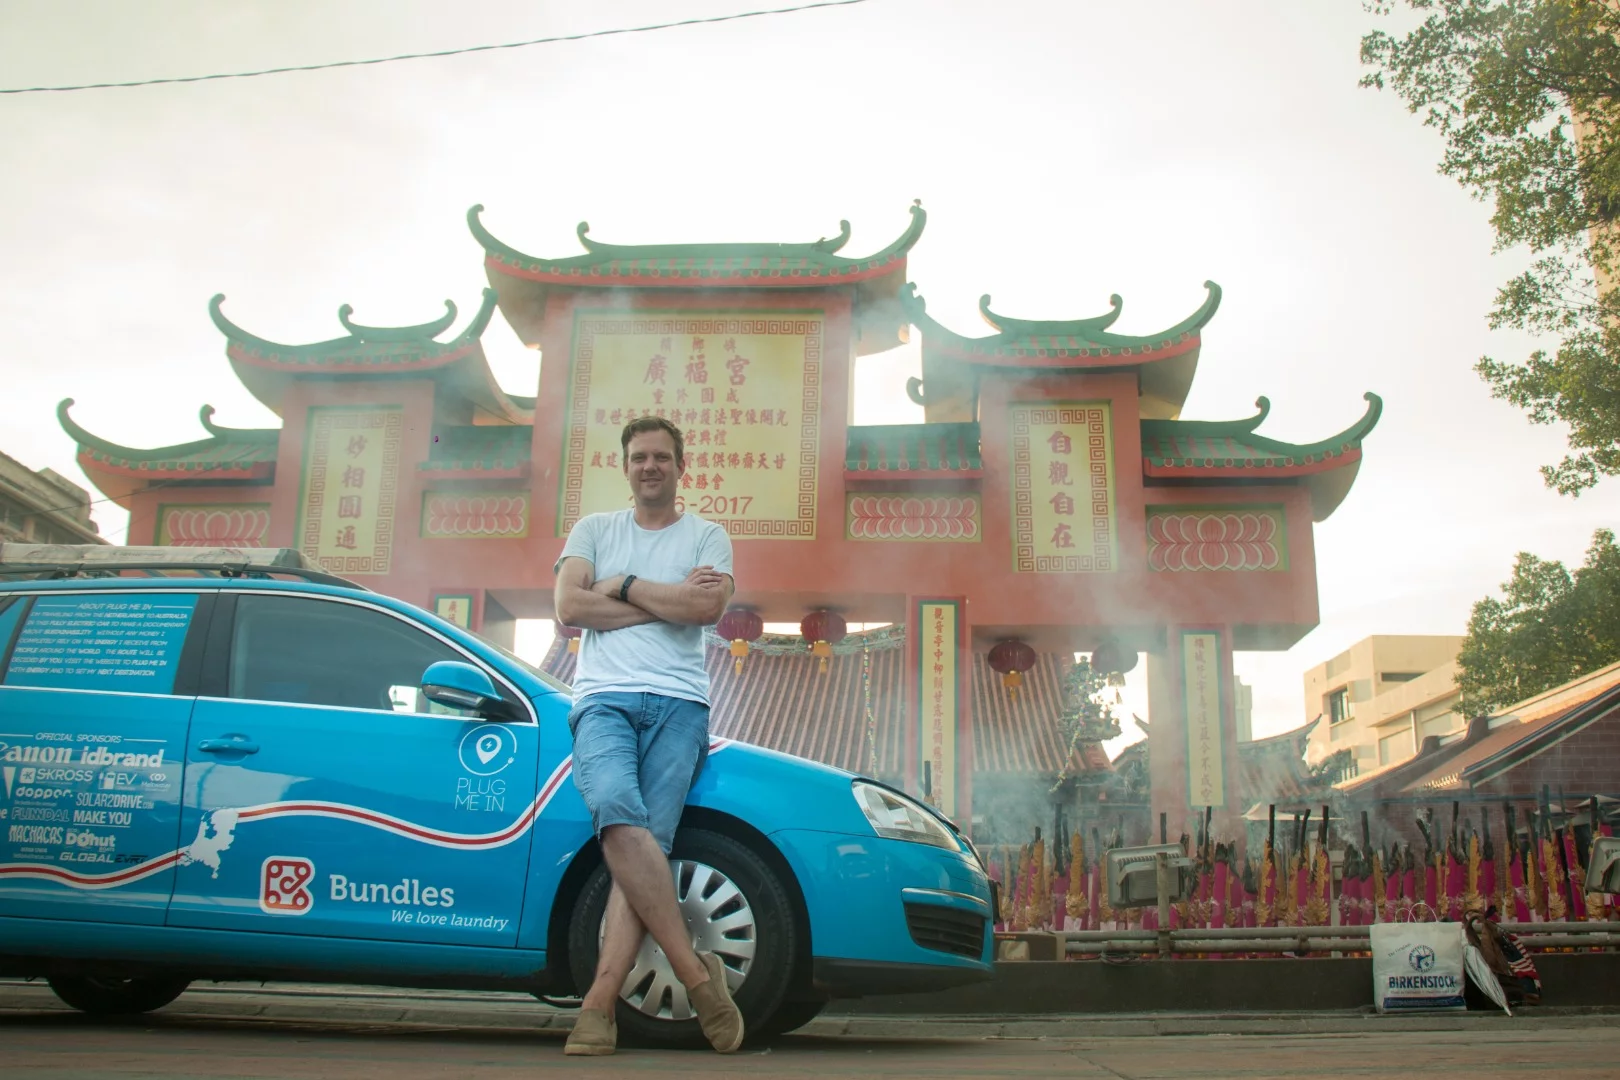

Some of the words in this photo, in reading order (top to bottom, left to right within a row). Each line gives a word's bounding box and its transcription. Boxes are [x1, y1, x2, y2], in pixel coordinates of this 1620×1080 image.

[643, 354, 750, 386] 廣福宮
[1047, 430, 1076, 549] 自觀自在
[35, 732, 74, 742] OFFICIAL
[76, 733, 122, 743] SPONSORS
[80, 746, 165, 768] idbrand
[36, 768, 93, 782] SKROSS
[116, 772, 138, 785] EV
[456, 777, 506, 795] PLUG
[455, 795, 480, 811] ME
[484, 796, 505, 812] IN
[73, 809, 107, 824] MAKE
[108, 811, 132, 825] YOU
[59, 851, 114, 863] GLOBAL
[329, 874, 455, 907] Bundles
[391, 910, 413, 923] We
[416, 911, 447, 926] love
[450, 913, 509, 931] laundry
[1388, 975, 1457, 989] BIRKENSTOCK
